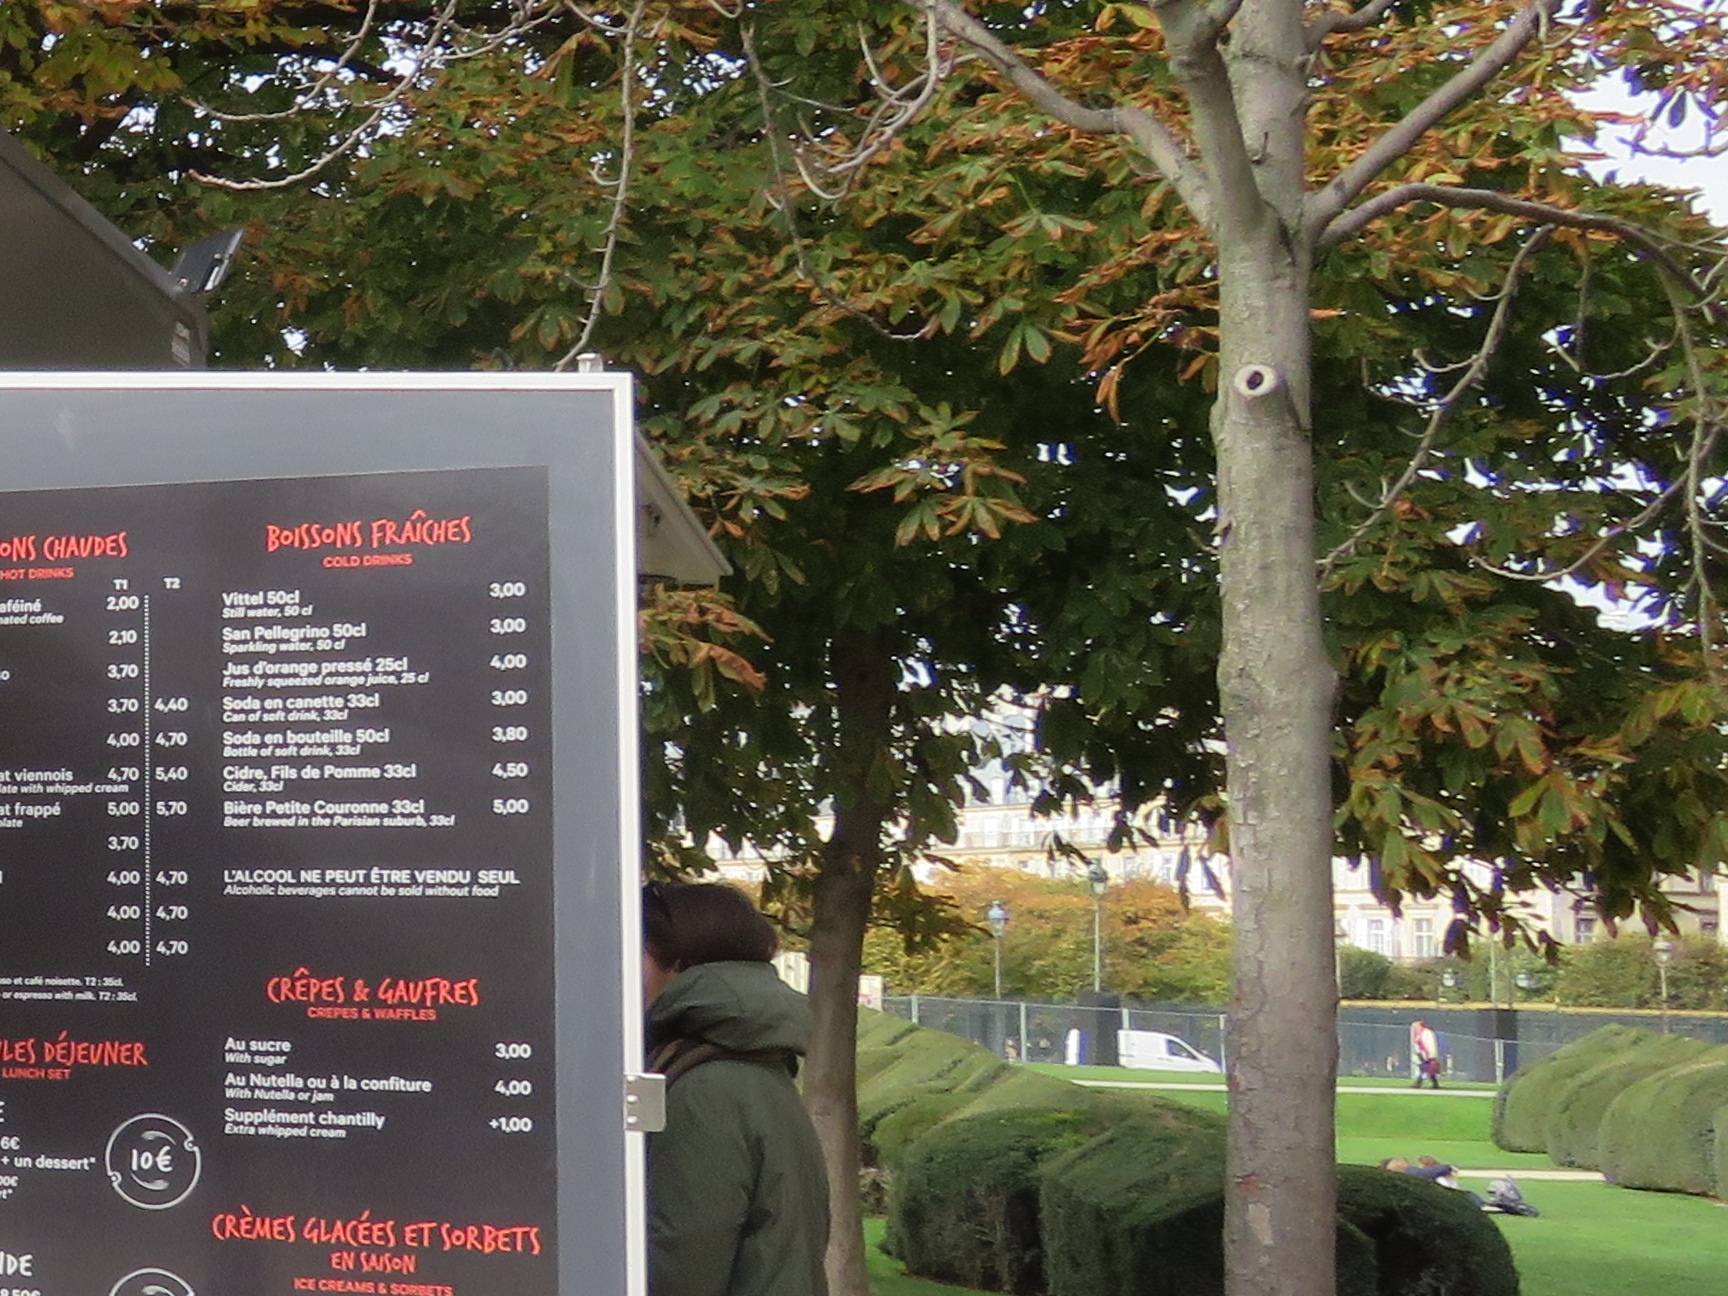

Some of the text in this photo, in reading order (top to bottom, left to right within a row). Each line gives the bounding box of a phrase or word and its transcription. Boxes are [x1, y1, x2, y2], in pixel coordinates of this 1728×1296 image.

[266, 509, 472, 552] BOISSONS FRAÎCHES
[44, 532, 128, 561] CHAUDES
[323, 555, 414, 568] COLD DRINKS
[28, 567, 75, 580] DRINKS
[114, 578, 181, 590] T1 T2
[490, 583, 526, 598] 3,00
[106, 597, 139, 611] 2,00
[222, 590, 300, 606] Vittel 50cl
[222, 623, 366, 641] San Pellegrino 50cl
[491, 619, 526, 634] 3,00
[108, 630, 137, 644] 2,10
[222, 662, 249, 676] Jus
[322, 658, 372, 675] pressé
[375, 658, 407, 671] 25cl
[490, 655, 527, 670] 4,00
[108, 664, 138, 679] 3,70
[108, 699, 138, 712] 3,70
[155, 698, 188, 712] 4,40
[222, 694, 379, 710] Soda en canette 33cl
[492, 691, 527, 706] 3,00
[106, 734, 140, 748] 4,00
[155, 732, 188, 747] 4,70
[223, 729, 390, 745] Soda en bouteille 50cl
[492, 728, 528, 743] 3,80
[14, 770, 73, 782] viennois
[108, 768, 139, 782] 4,70
[155, 768, 188, 782] 5,40
[223, 764, 416, 781] Cidre, Fils de Pomme 33cl
[492, 764, 528, 779] 4,50
[14, 802, 60, 818] frappé
[107, 802, 139, 816] 5,00
[156, 802, 188, 816] 5,70
[224, 800, 424, 815] Bière Petite Couronne 33cl
[493, 800, 529, 815] 5,00
[108, 836, 138, 850] 3,70
[107, 872, 140, 886] 4,00
[156, 872, 188, 886] 4,70
[300, 871, 322, 883] NE
[326, 871, 367, 883] PEUT
[370, 867, 411, 883] ÊTRE
[415, 870, 471, 883] VENDU
[478, 871, 520, 884] SEUL
[107, 906, 140, 920] 4,00
[156, 906, 188, 920] 4,70
[107, 940, 140, 955] 4,00
[156, 940, 188, 955] 4,70
[267, 967, 345, 1003] CRÊPES
[378, 977, 479, 1007] GAUFRES
[44, 1030, 148, 1067] DÉJEUNER
[225, 1038, 292, 1052] Au sucre
[495, 1044, 531, 1058] 3,00
[495, 1081, 532, 1096] 4,00
[225, 1108, 385, 1130] Supplément chantilly
[130, 1146, 173, 1172] 10€
[212, 1205, 540, 1254] CRÈMES GLACÉES ET SORBETS
